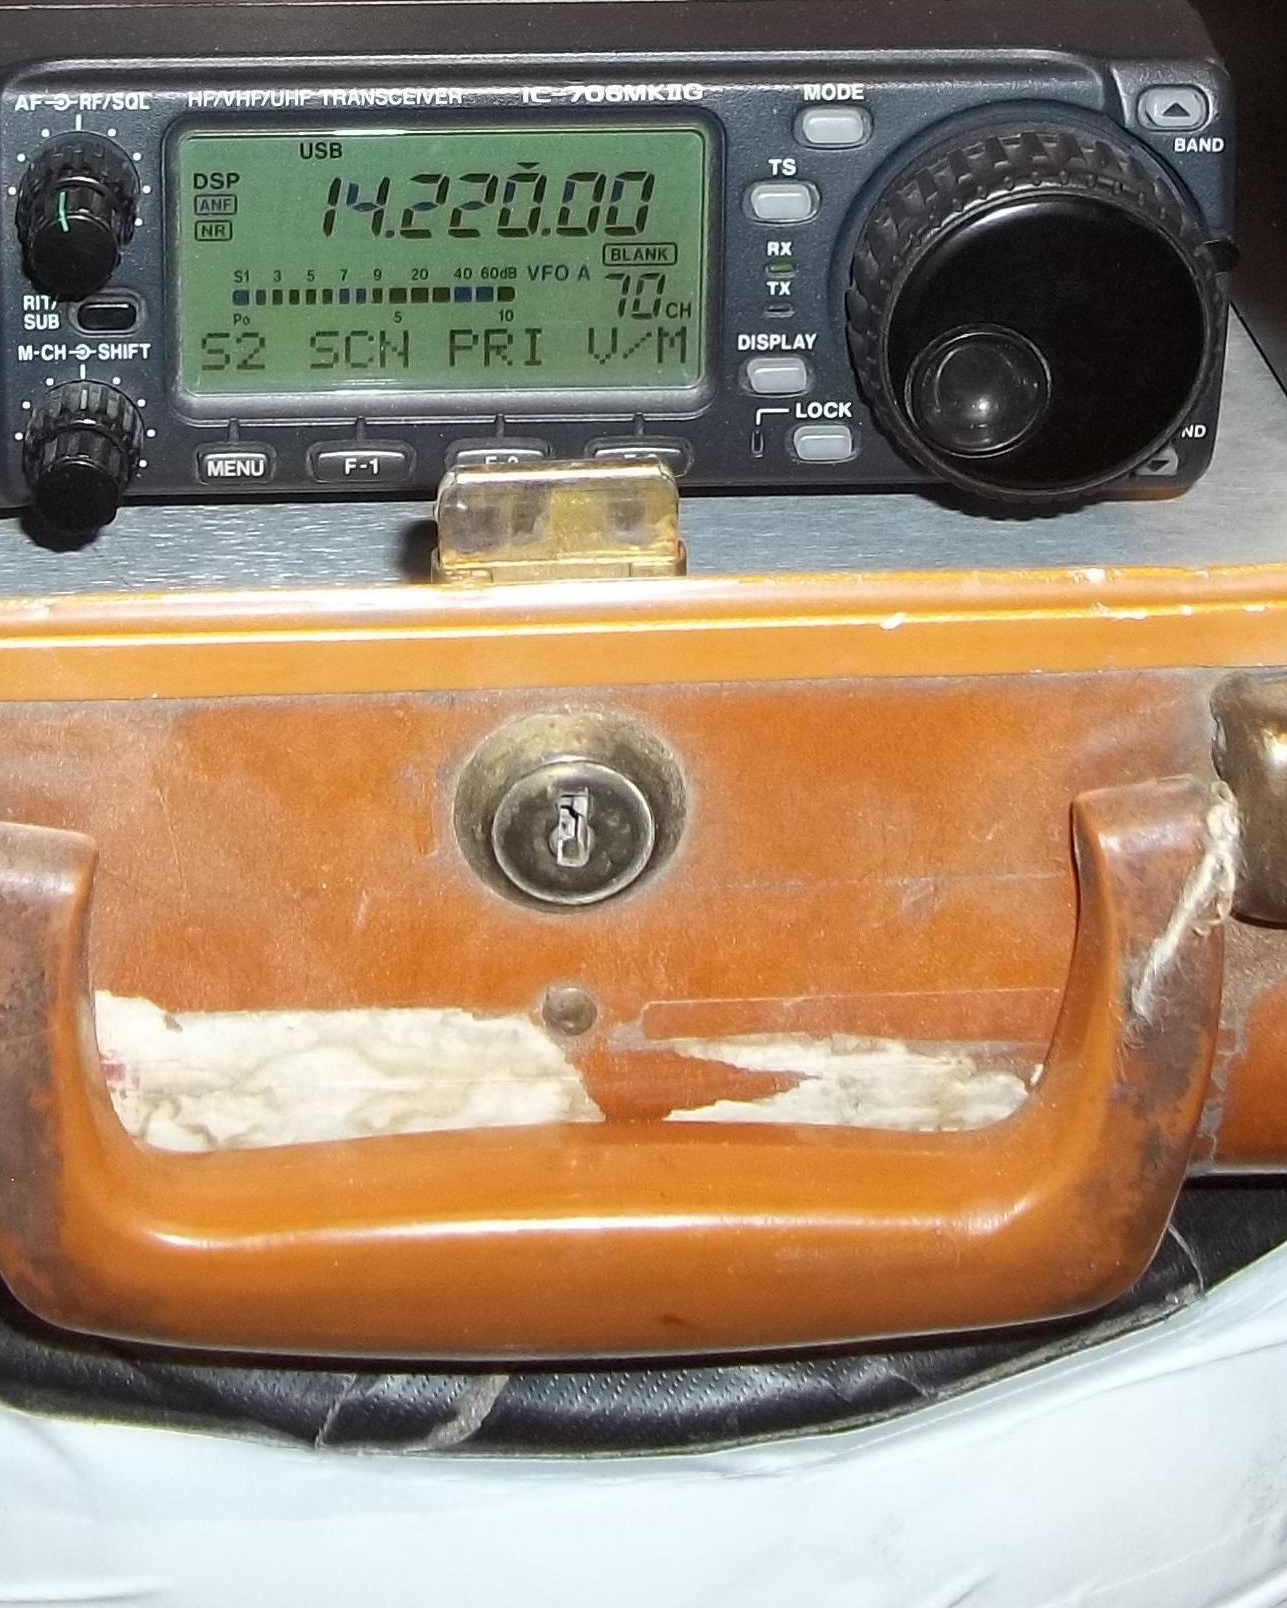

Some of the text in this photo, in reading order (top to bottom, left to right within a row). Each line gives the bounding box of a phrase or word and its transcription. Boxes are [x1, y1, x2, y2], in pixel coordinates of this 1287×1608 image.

[188, 88, 464, 107] HF/VHF/UHF TRANSCEIVER
[521, 83, 704, 103] IC-706MKIIG
[804, 84, 865, 101] MODE
[299, 142, 343, 159] USB
[1174, 138, 1224, 152] BAND
[769, 159, 797, 176] TS
[193, 173, 240, 189] DSP
[199, 199, 232, 212] ANF
[323, 171, 655, 238] 14.220.00
[201, 224, 226, 238] NR
[611, 247, 668, 261] BLANK
[767, 242, 793, 256] RX
[234, 266, 517, 283] S1 3 5 7 9 20 40 60dB
[527, 264, 591, 281] VFO A
[605, 273, 691, 320] 70 CH
[767, 282, 791, 295] TX
[24, 314, 60, 330] SUB
[234, 309, 514, 326] Po 5 10
[309, 330, 409, 369] SCN
[449, 328, 542, 367] PRI
[587, 326, 687, 365] V/M
[738, 334, 816, 350] DISPLAY
[99, 343, 151, 359] SHIFT
[795, 402, 852, 418] LOCK
[1181, 425, 1206, 438] ND
[207, 460, 264, 477] MENU
[344, 458, 378, 474] F-1
